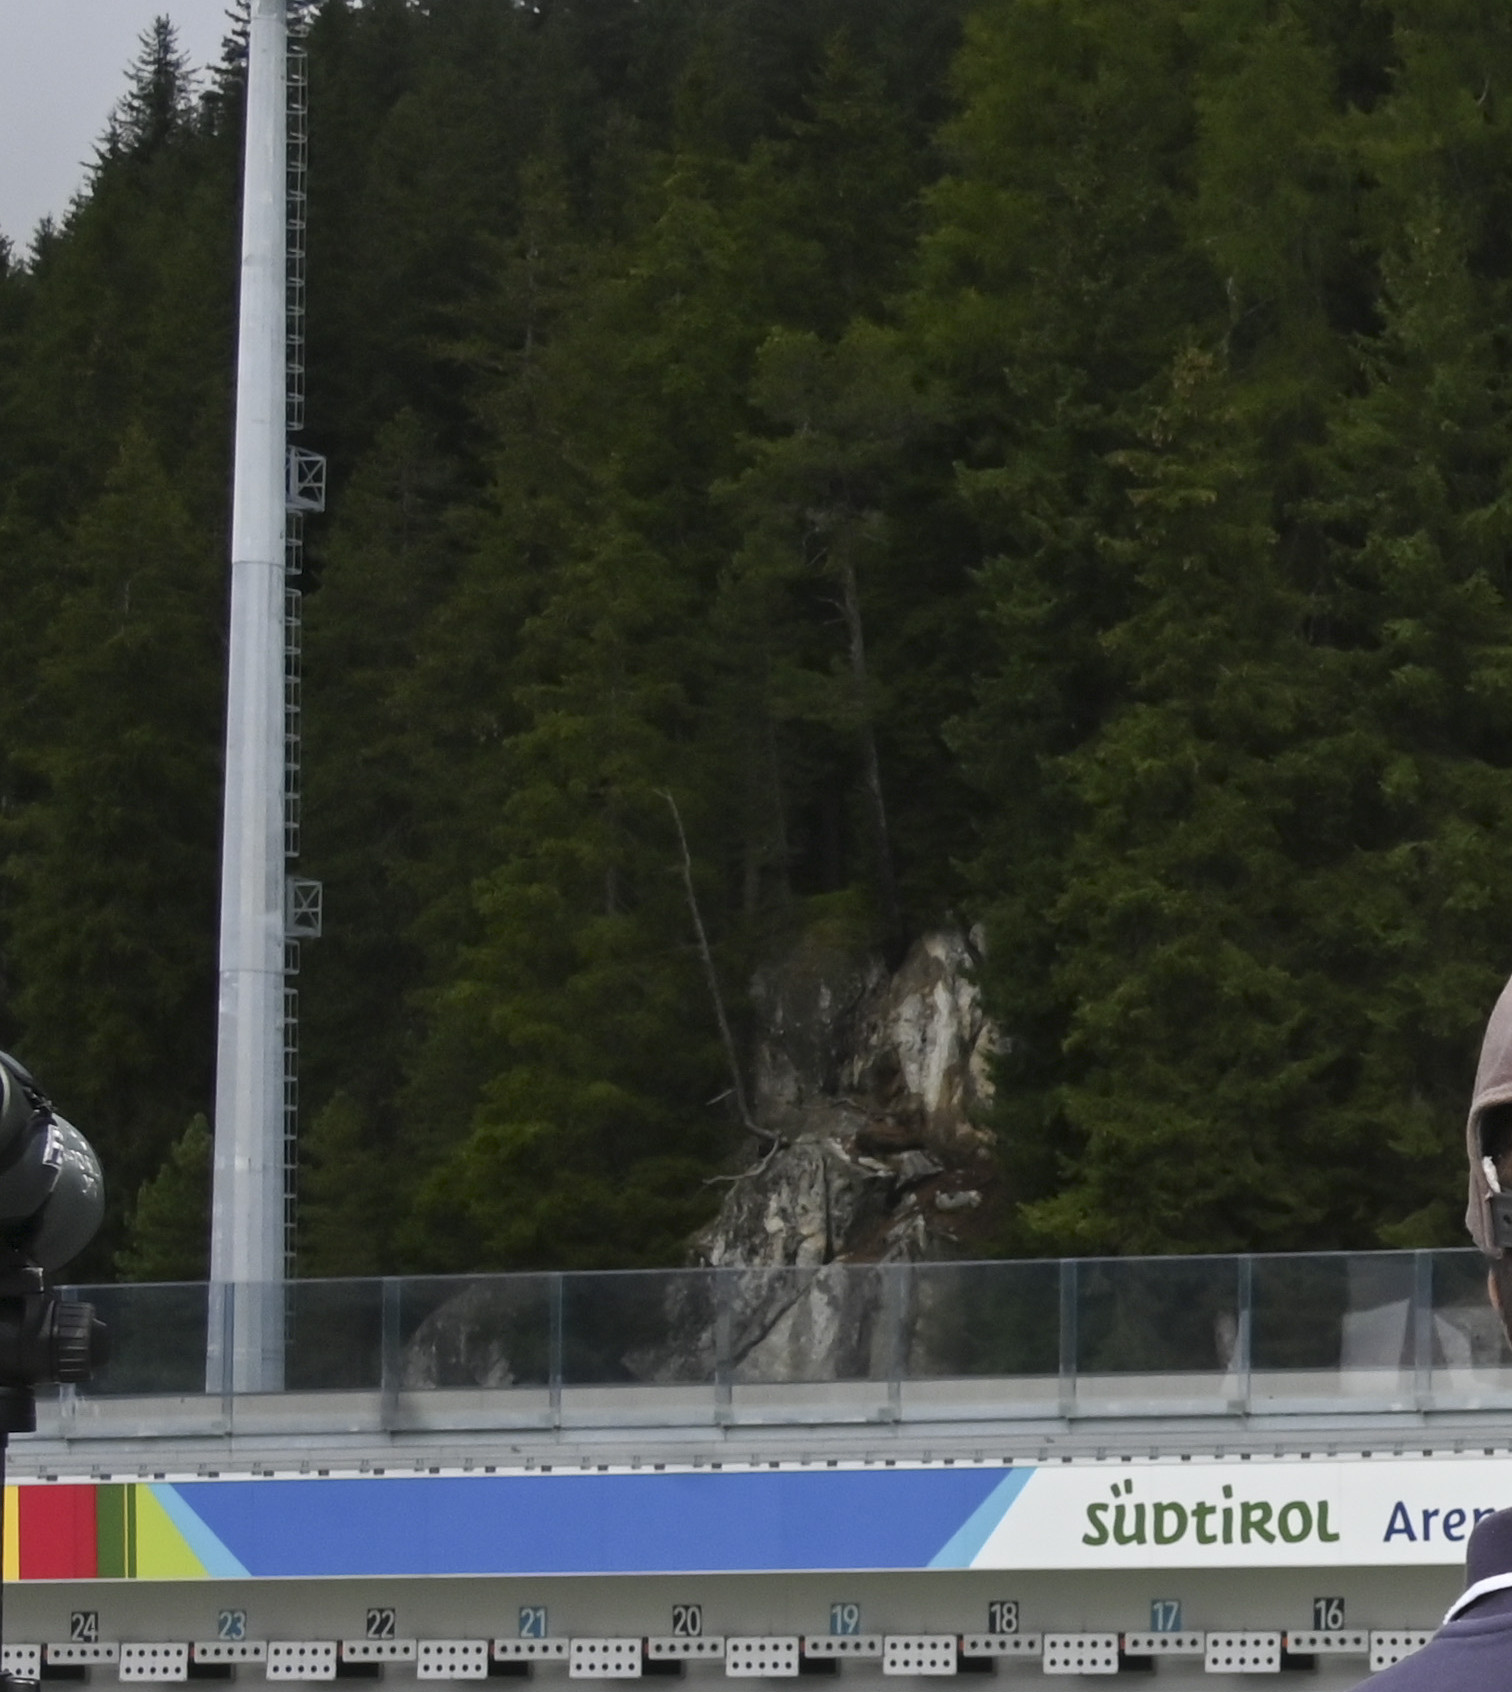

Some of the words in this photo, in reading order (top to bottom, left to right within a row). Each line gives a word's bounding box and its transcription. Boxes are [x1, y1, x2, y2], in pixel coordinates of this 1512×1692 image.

[71, 1611, 98, 1642] 24
[218, 1610, 247, 1640] 23
[367, 1609, 395, 1639] 22
[520, 1607, 547, 1638] 21
[673, 1606, 701, 1636] 20
[831, 1604, 859, 1635] 19
[990, 1602, 1018, 1633] 18
[1152, 1601, 1179, 1632] 17
[1315, 1600, 1344, 1631] 16
